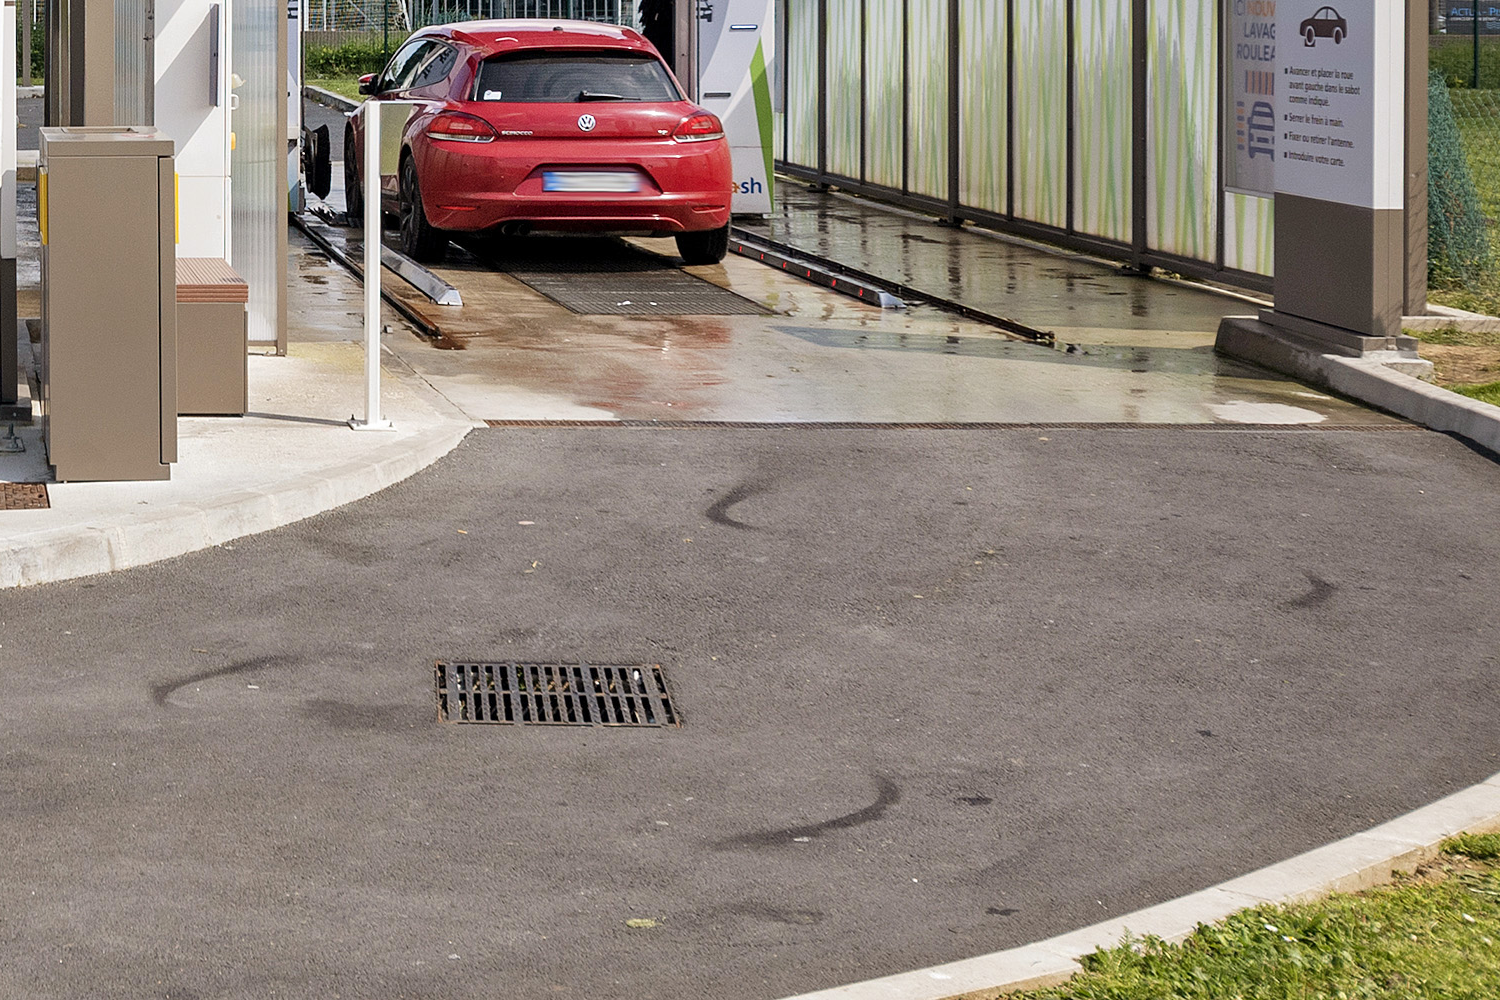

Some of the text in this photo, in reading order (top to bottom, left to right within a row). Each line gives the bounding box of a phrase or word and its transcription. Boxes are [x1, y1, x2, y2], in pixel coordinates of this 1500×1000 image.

[1289, 66, 1354, 80] Avancer et placer la roue
[1289, 81, 1361, 95] avant gauche dans le sabot
[1289, 96, 1307, 104] comme
[1289, 112, 1304, 123] Serrer
[1305, 114, 1311, 124] le
[1311, 114, 1324, 125] frein
[1289, 131, 1301, 142] Fixer
[1302, 135, 1309, 143] ou
[1310, 136, 1327, 145] retirer
[1288, 150, 1314, 162] Introduire
[1315, 156, 1329, 165] votre
